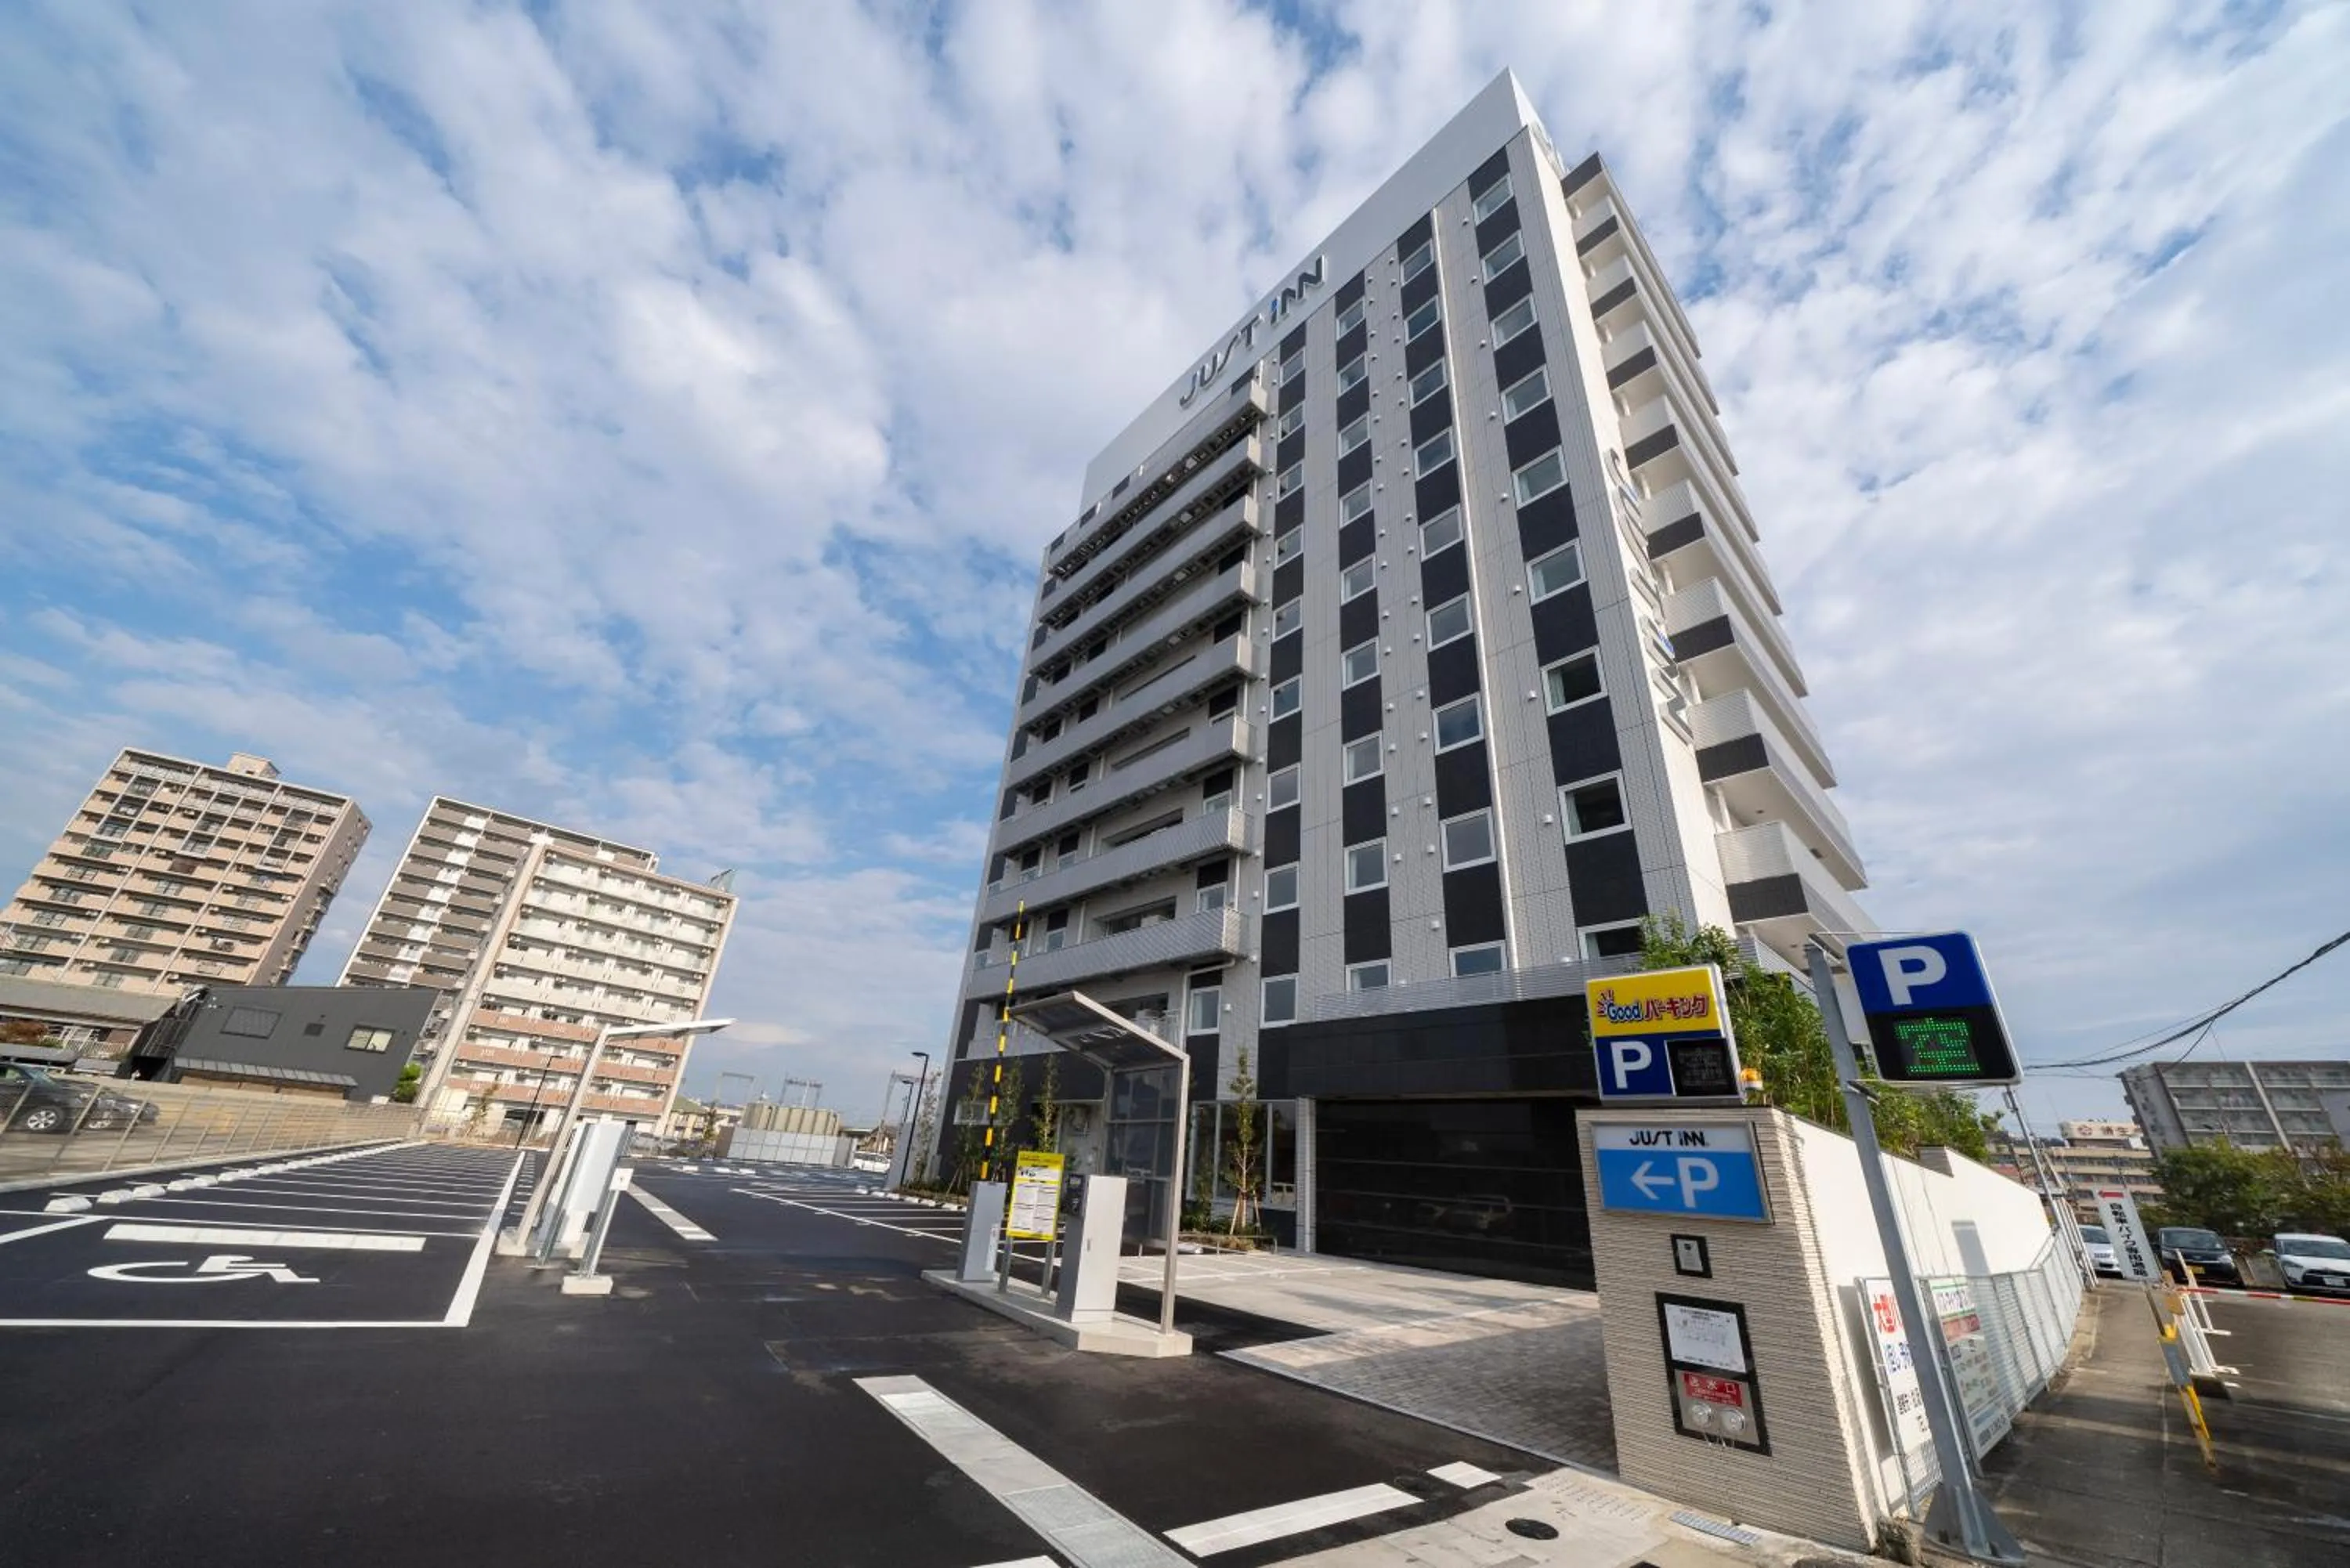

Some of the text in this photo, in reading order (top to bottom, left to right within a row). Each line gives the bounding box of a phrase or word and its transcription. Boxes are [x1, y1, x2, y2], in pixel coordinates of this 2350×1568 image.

[1179, 254, 1326, 406] JUST INN
[1878, 945, 1947, 1006] P
[1607, 994, 1709, 1022] Good パーキング
[1610, 1040, 1652, 1089] P
[1896, 1017, 1980, 1073] 空
[1629, 1130, 1705, 1147] JUST INN
[1677, 1157, 1719, 1208] P
